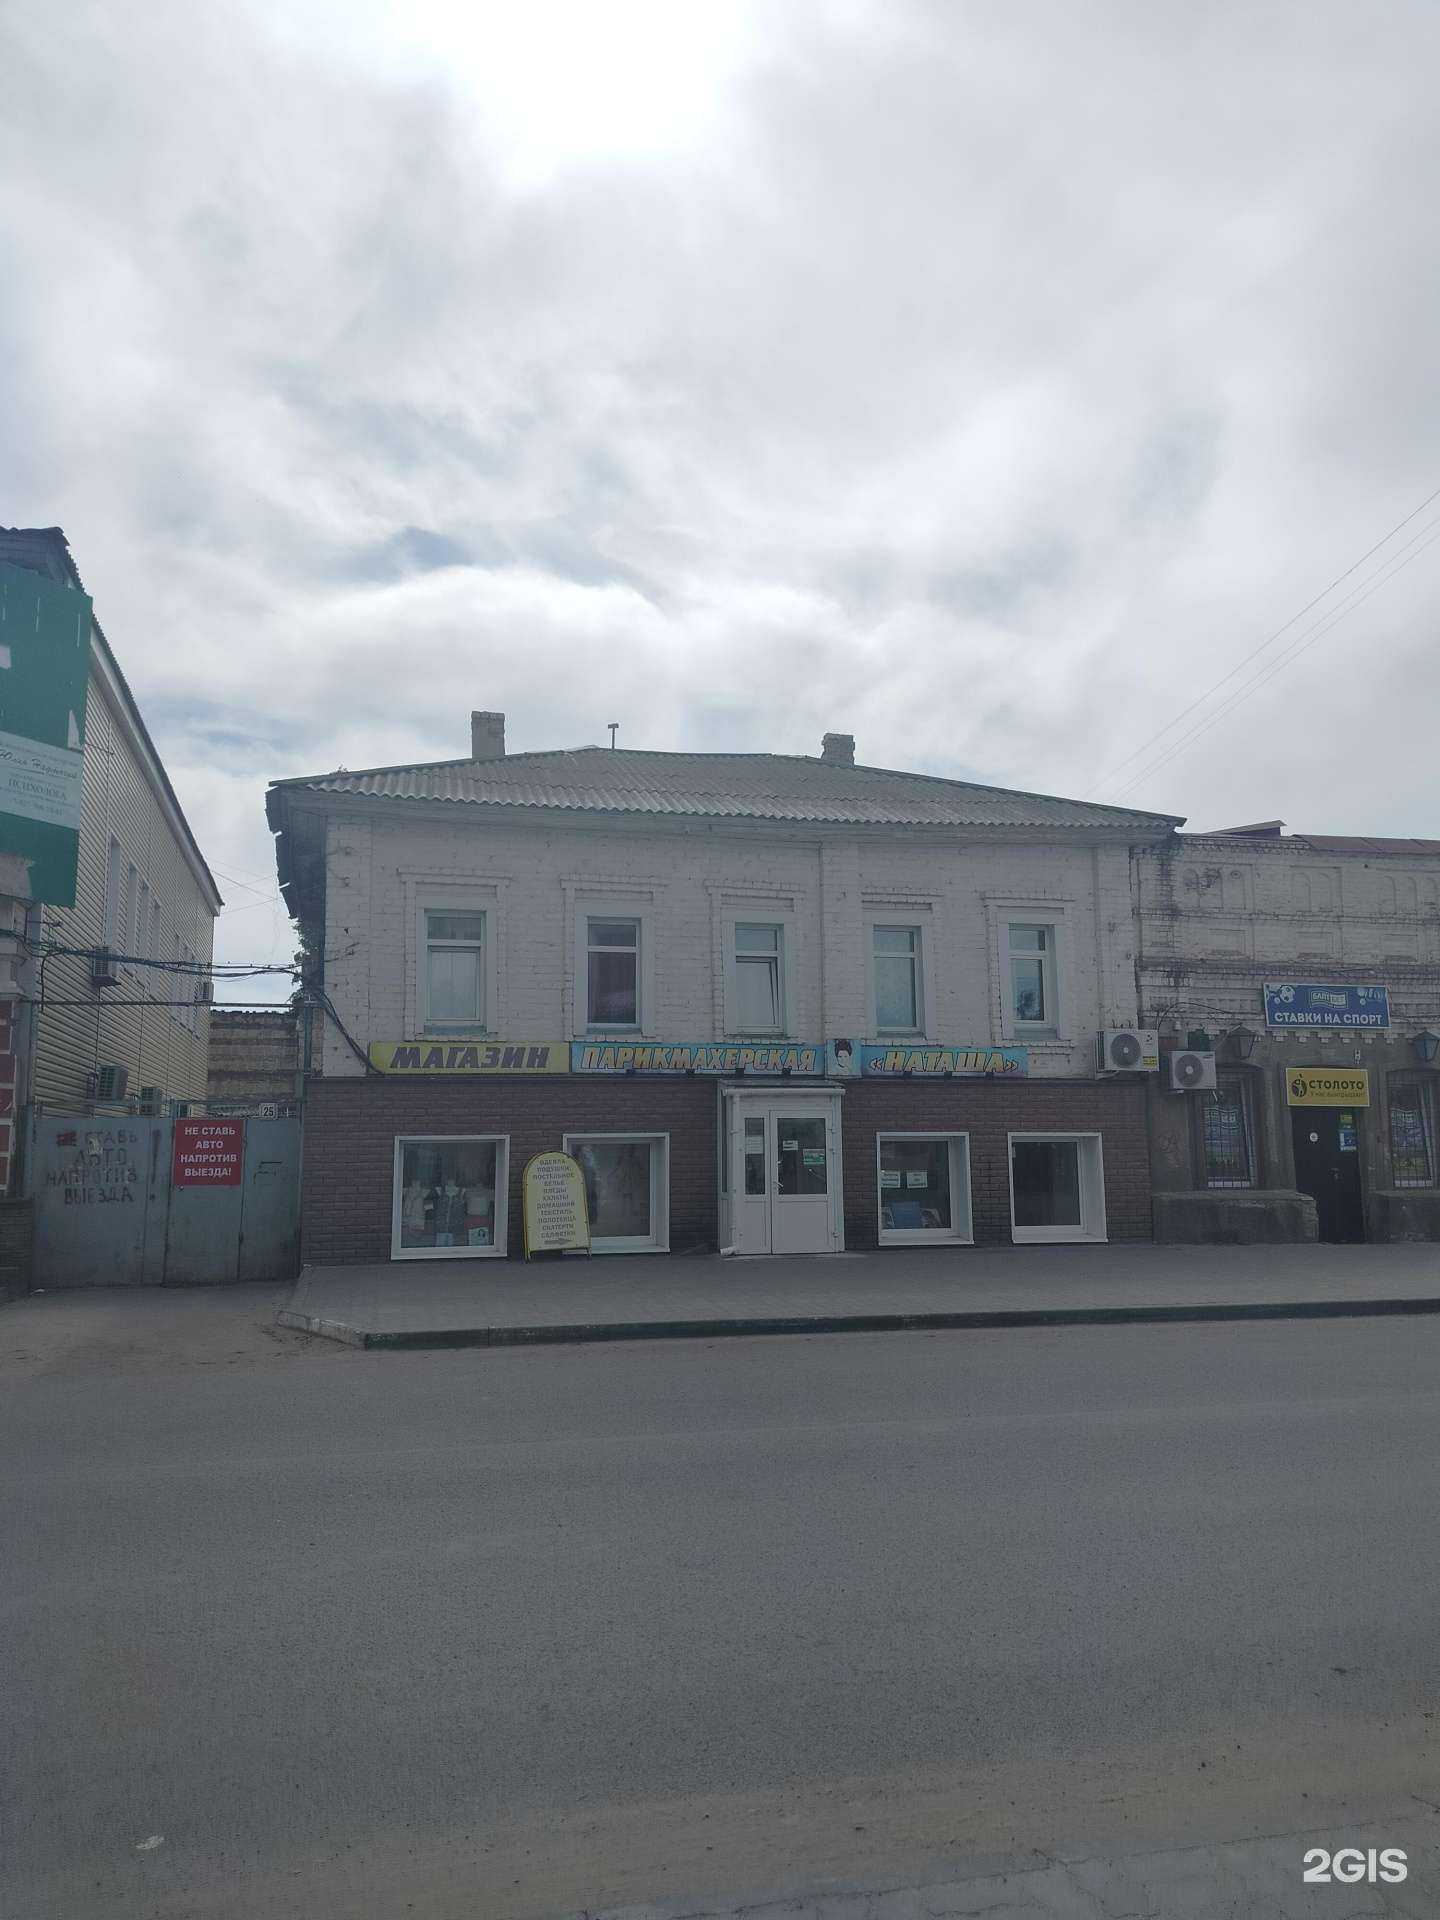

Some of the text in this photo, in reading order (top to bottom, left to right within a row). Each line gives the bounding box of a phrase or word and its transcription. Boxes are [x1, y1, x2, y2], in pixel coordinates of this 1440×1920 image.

[1274, 1012, 1382, 1025] СТАВКИ НА СПОРТ
[389, 1047, 550, 1069] МАГАЗИН
[581, 1046, 816, 1072] ПАРИКМАХЕРСКАЯ
[870, 1051, 1019, 1073] «НАТАША»
[1309, 1080, 1365, 1090] СТОЛОТО
[263, 1104, 274, 1117] 25
[184, 1126, 236, 1136] НЕ СТАВЬ
[195, 1140, 224, 1149] АВТО
[180, 1153, 238, 1163] НАПРОТИВ
[184, 1167, 232, 1178] ВЫЕЗДА!
